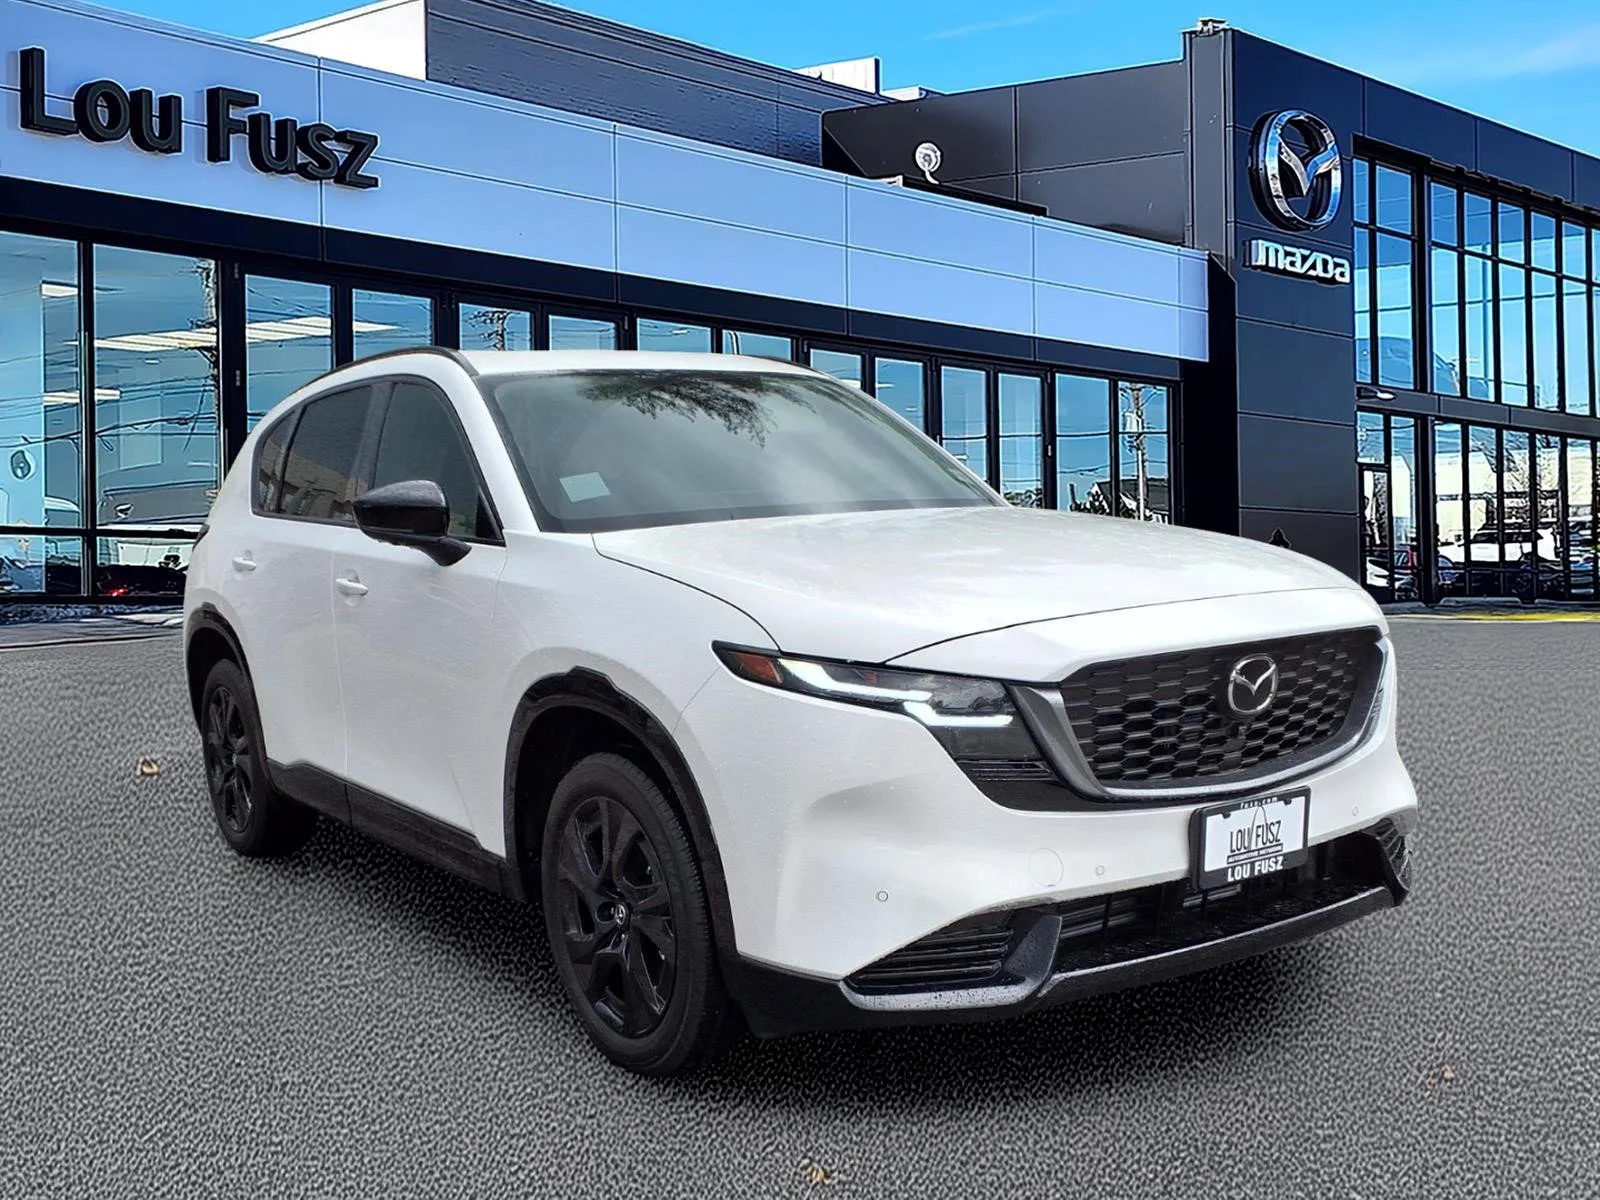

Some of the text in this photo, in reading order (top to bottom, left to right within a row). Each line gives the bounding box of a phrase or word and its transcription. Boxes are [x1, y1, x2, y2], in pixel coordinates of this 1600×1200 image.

[20, 46, 380, 189] Lou Fusz
[1230, 820, 1281, 853] LOU FUSZ
[1227, 856, 1283, 882] LOU FUSZ
